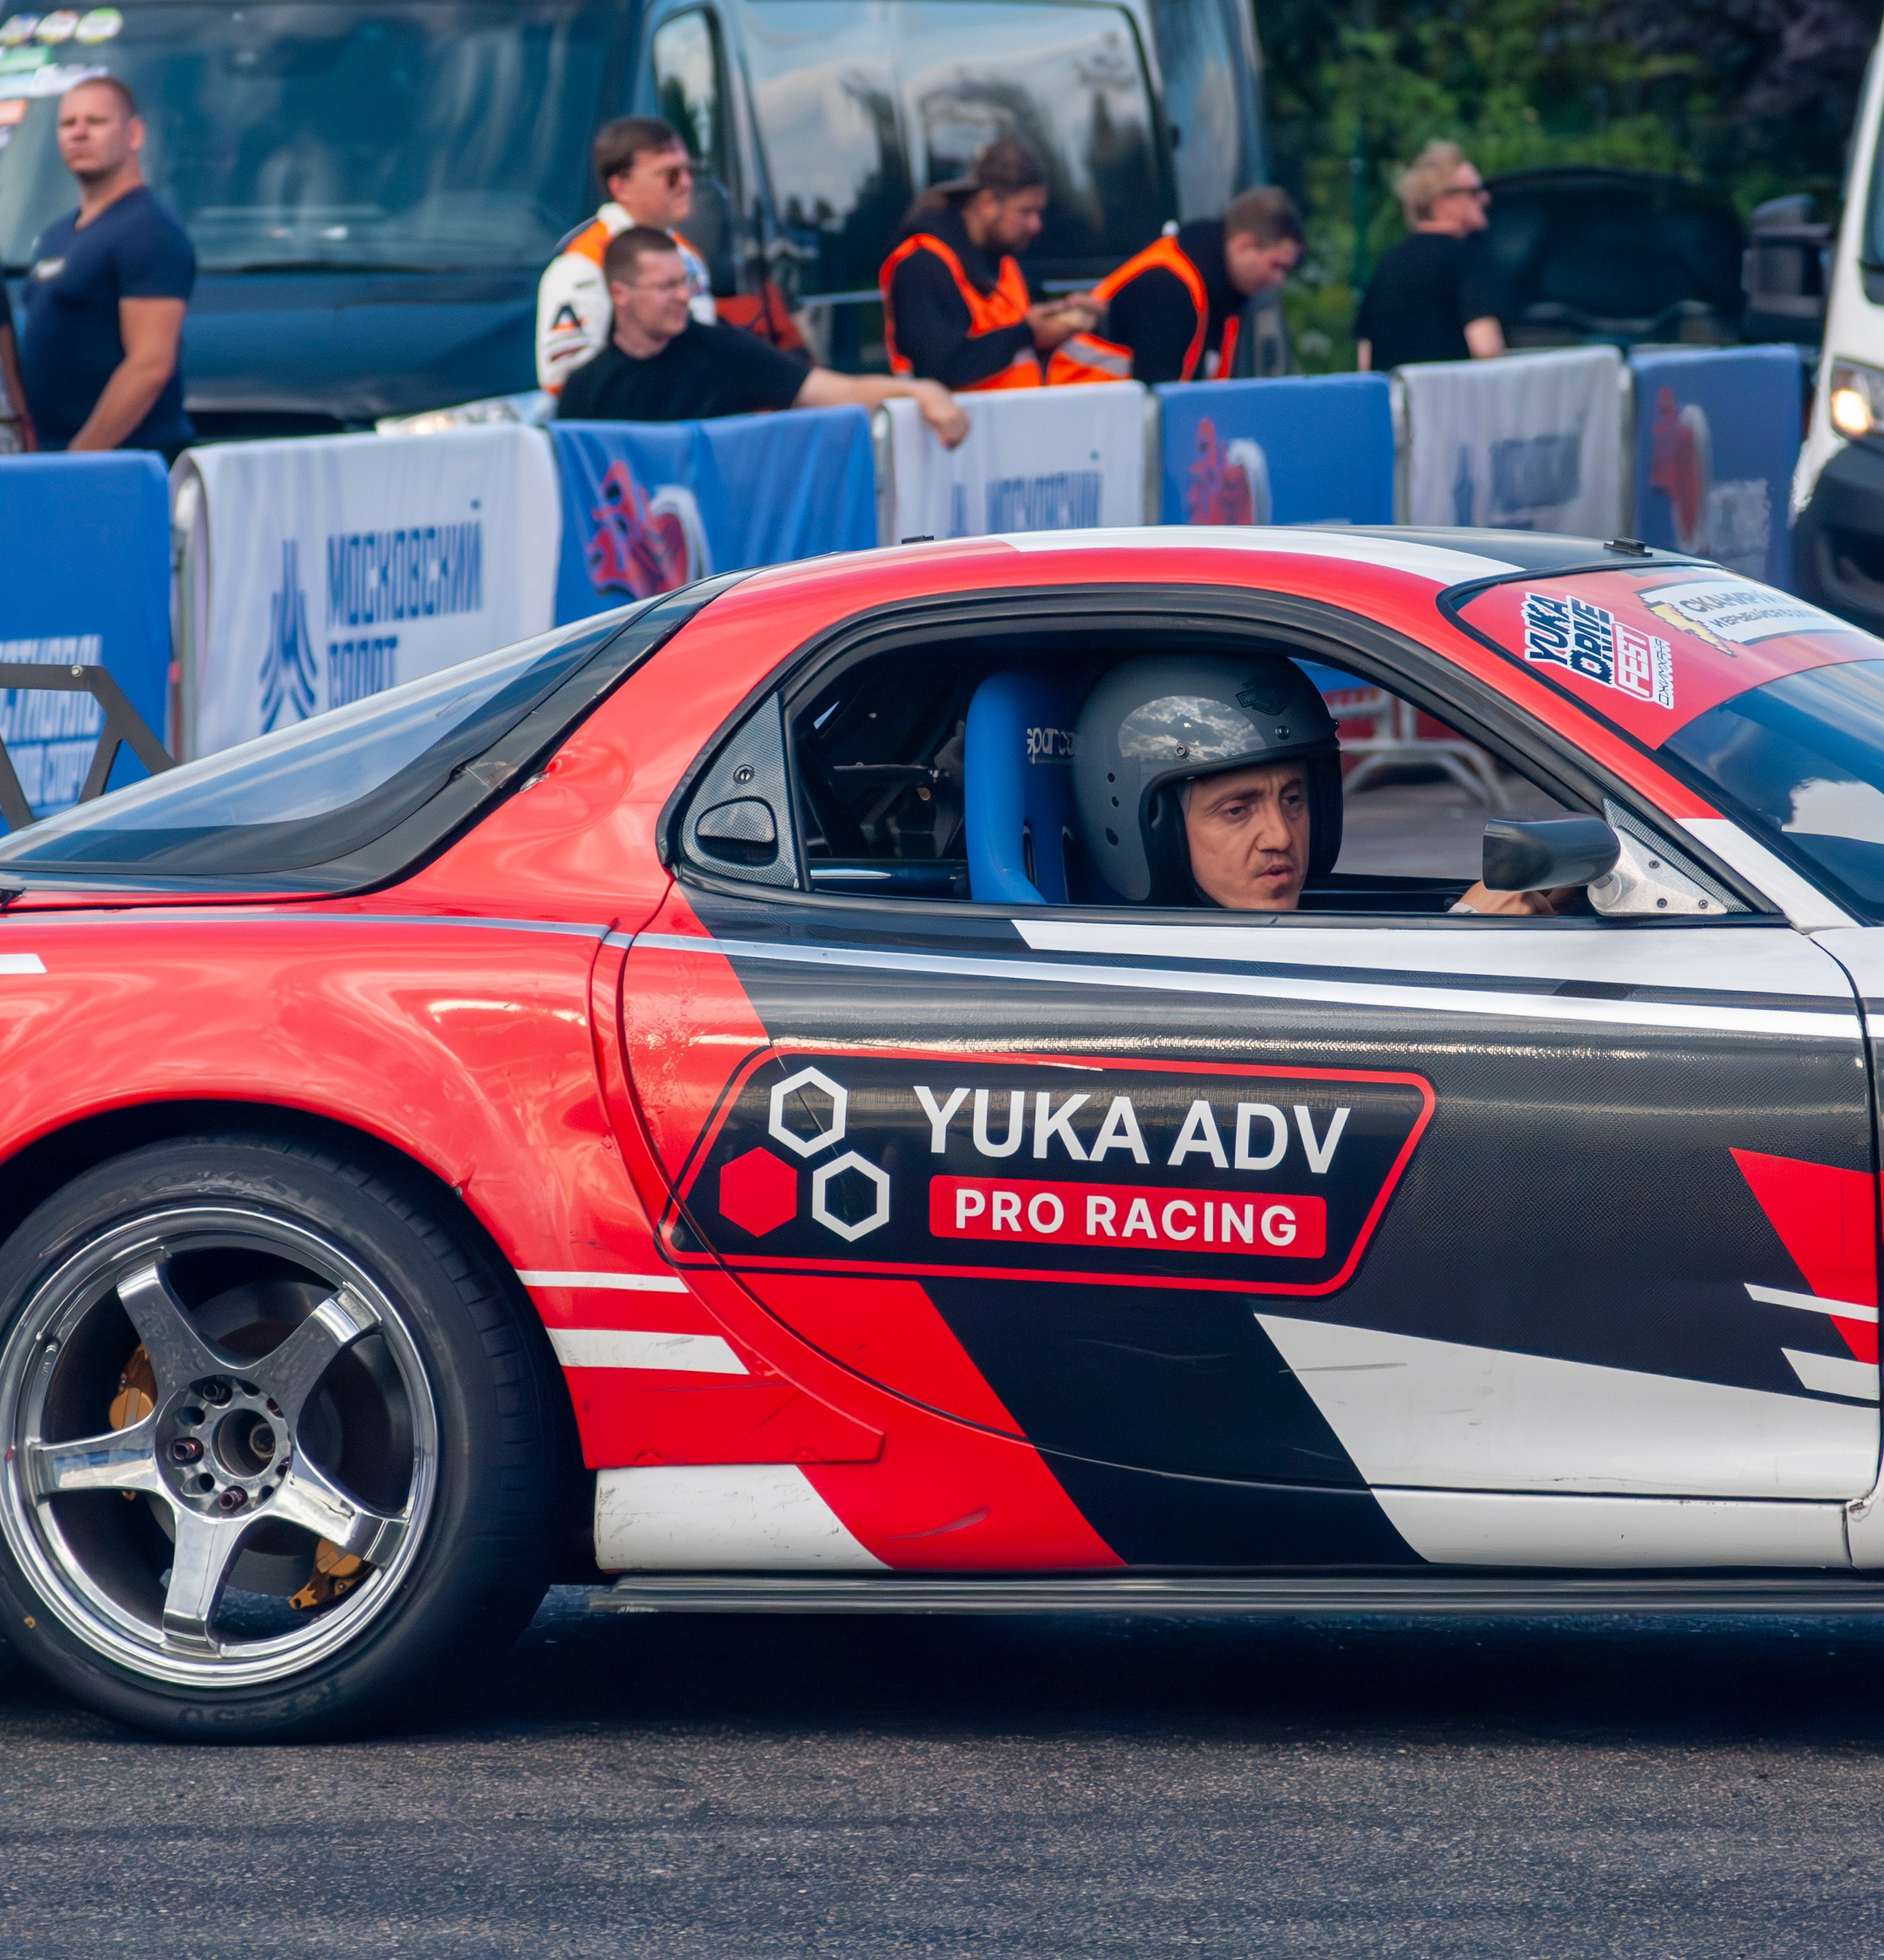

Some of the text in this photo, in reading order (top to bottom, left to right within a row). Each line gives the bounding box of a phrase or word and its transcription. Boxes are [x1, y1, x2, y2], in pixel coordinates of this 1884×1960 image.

[1527, 595, 1570, 665] YUKA
[1615, 624, 1650, 698] FEST
[913, 1086, 1350, 1173] YUKA ADV
[956, 1189, 1297, 1246] PRO RACING
